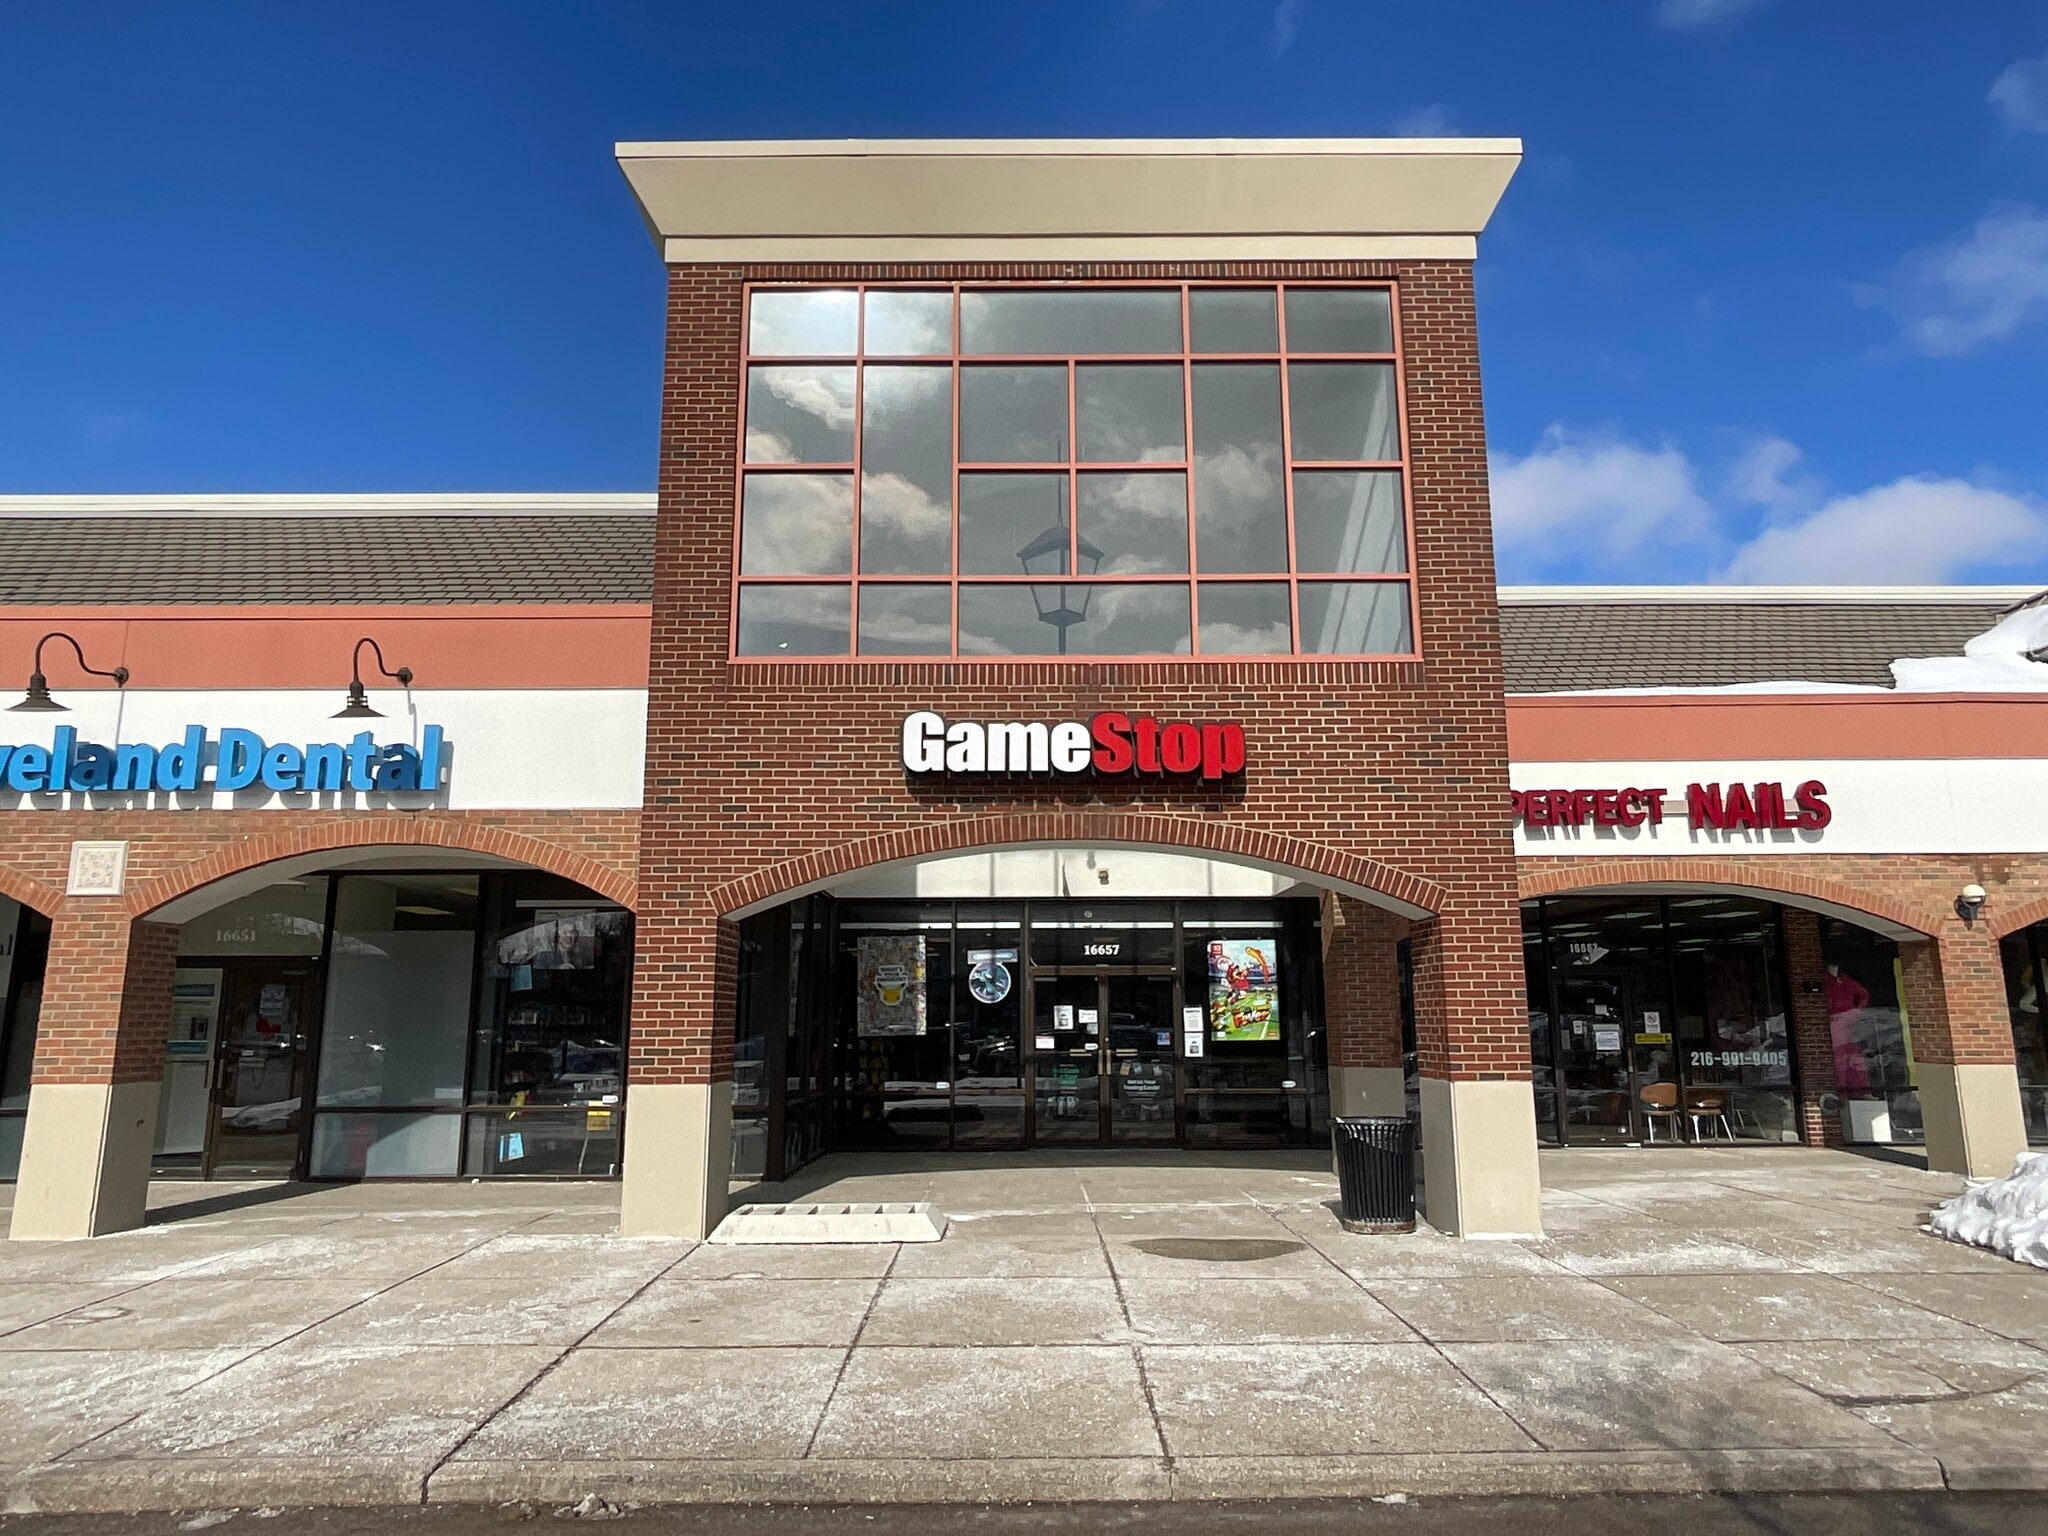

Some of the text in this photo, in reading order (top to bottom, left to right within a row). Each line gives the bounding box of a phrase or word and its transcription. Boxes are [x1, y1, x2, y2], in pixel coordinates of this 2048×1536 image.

[217, 725, 442, 791] Dental
[903, 711, 1246, 779] GameStop
[1511, 780, 1832, 830] PERFECT NAILS
[216, 930, 257, 942] 16651
[1084, 944, 1120, 956] 16657
